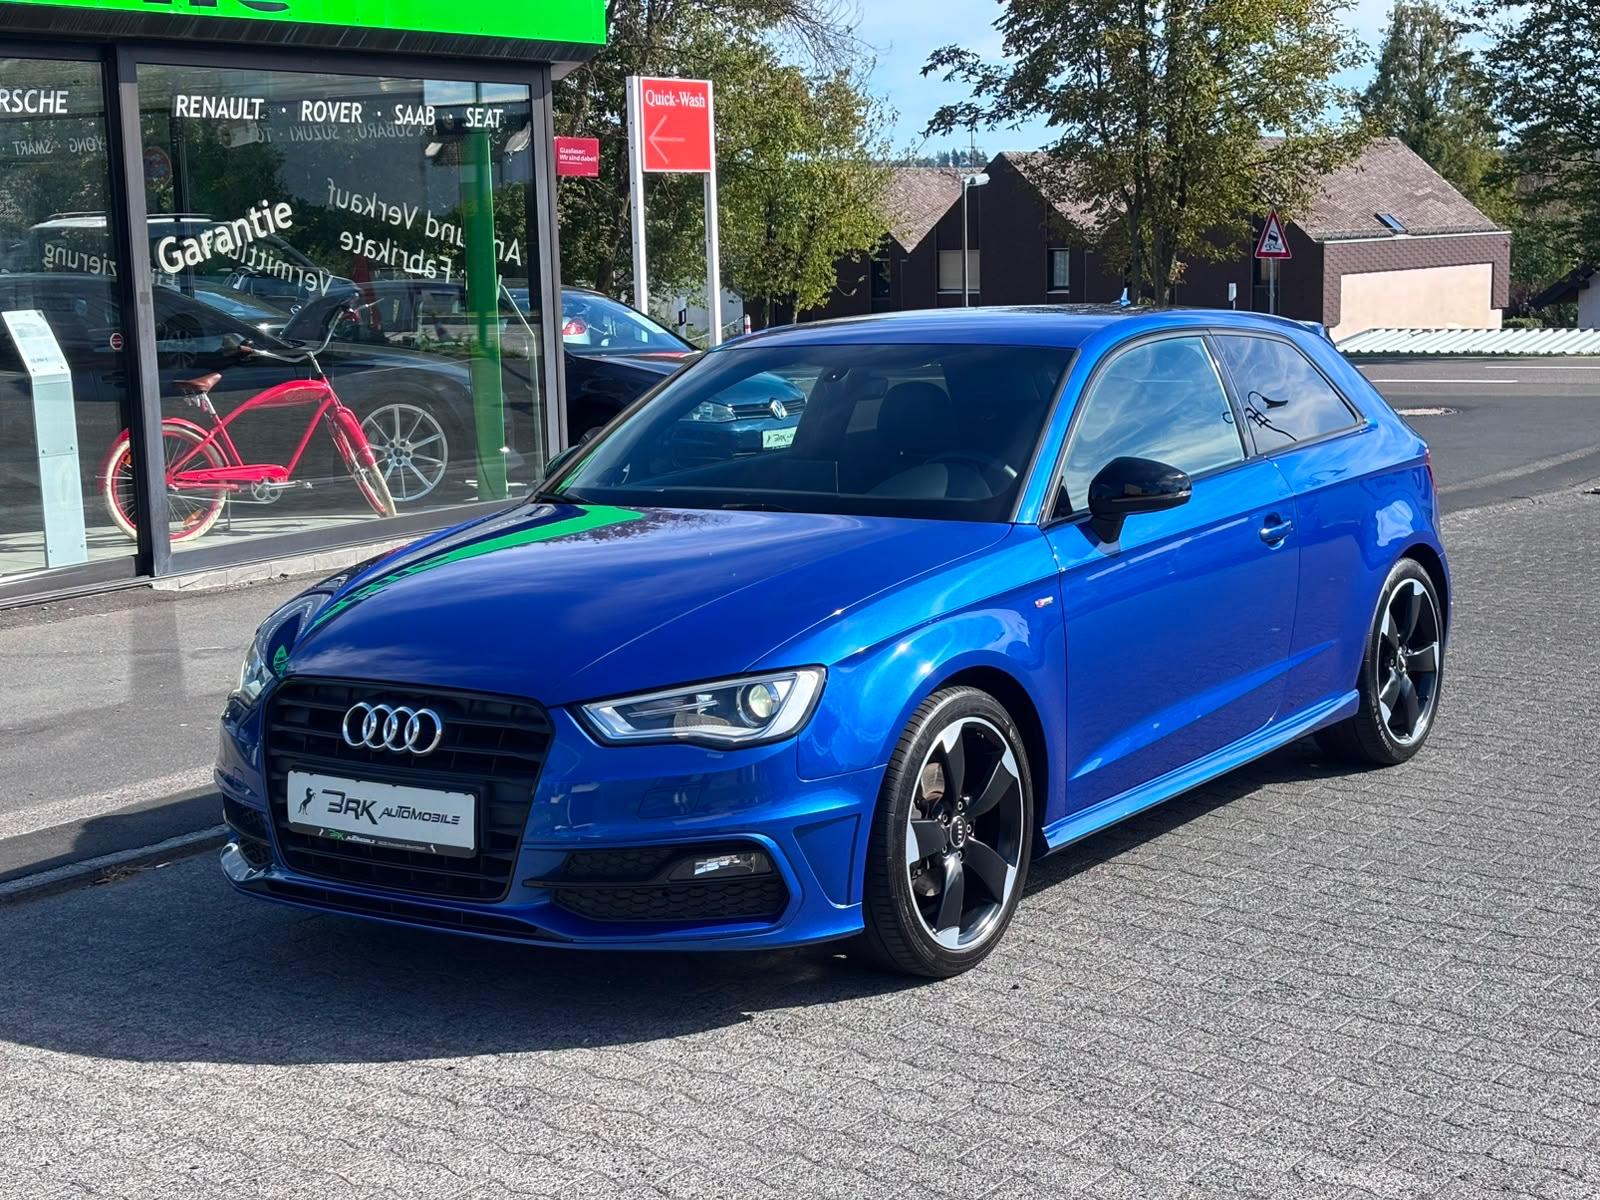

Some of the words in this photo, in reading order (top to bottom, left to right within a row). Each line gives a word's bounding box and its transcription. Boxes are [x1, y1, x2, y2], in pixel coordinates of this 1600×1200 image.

[175, 95, 265, 120] RENAULT
[301, 100, 363, 124] ROVER
[394, 104, 436, 126] SAAB
[465, 107, 504, 129] SEAT
[645, 89, 706, 109] Quick-Wash
[158, 199, 293, 274] Garantie
[378, 804, 461, 826] AUTOMOBILE
